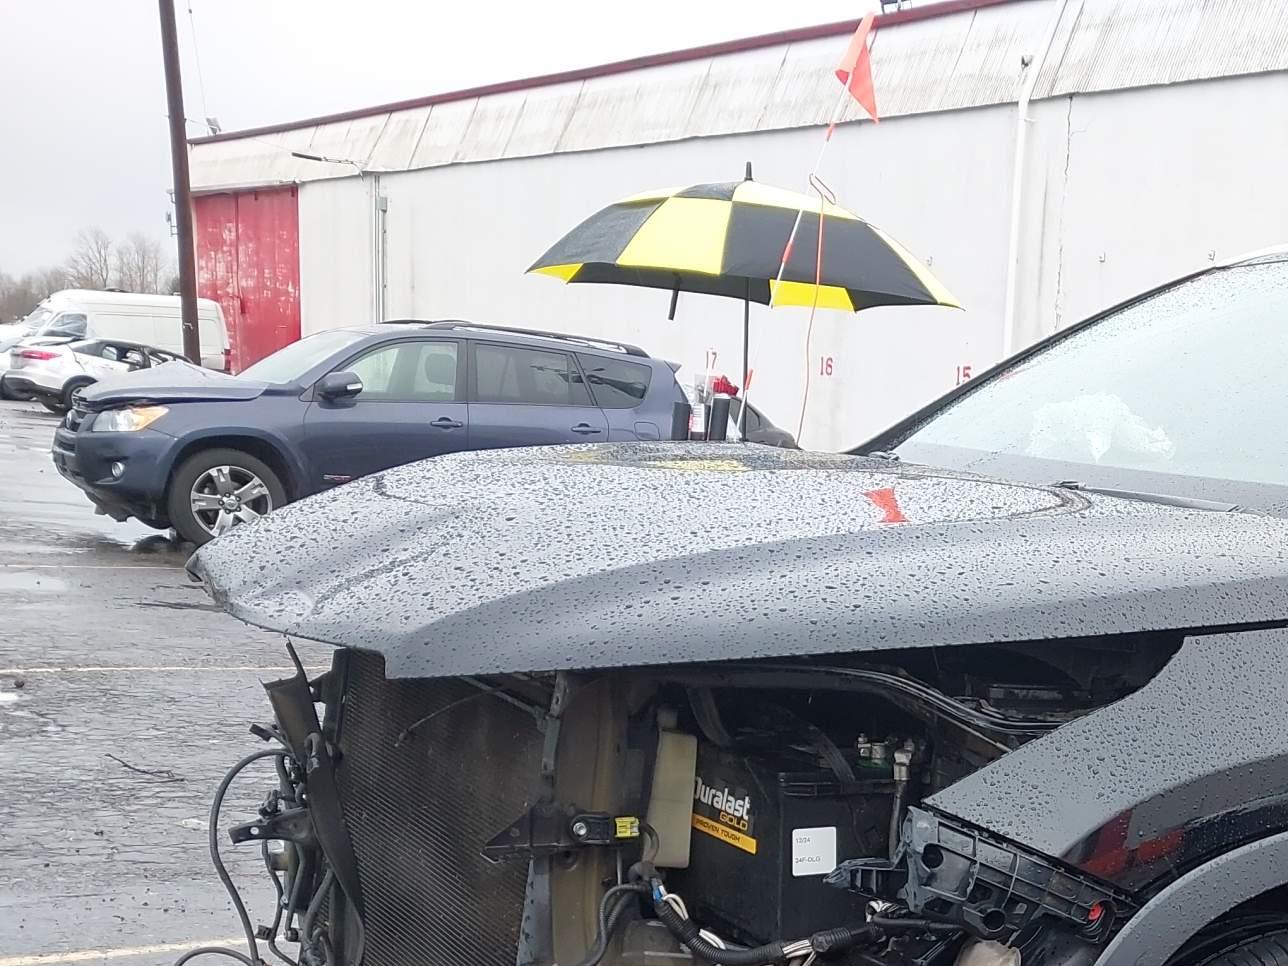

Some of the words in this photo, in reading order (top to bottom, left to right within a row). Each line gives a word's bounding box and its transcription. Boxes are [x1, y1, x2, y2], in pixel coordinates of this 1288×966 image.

[705, 351, 717, 369] 17
[819, 356, 833, 376] 16
[956, 365, 971, 385] 15
[719, 811, 748, 831] GOLD
